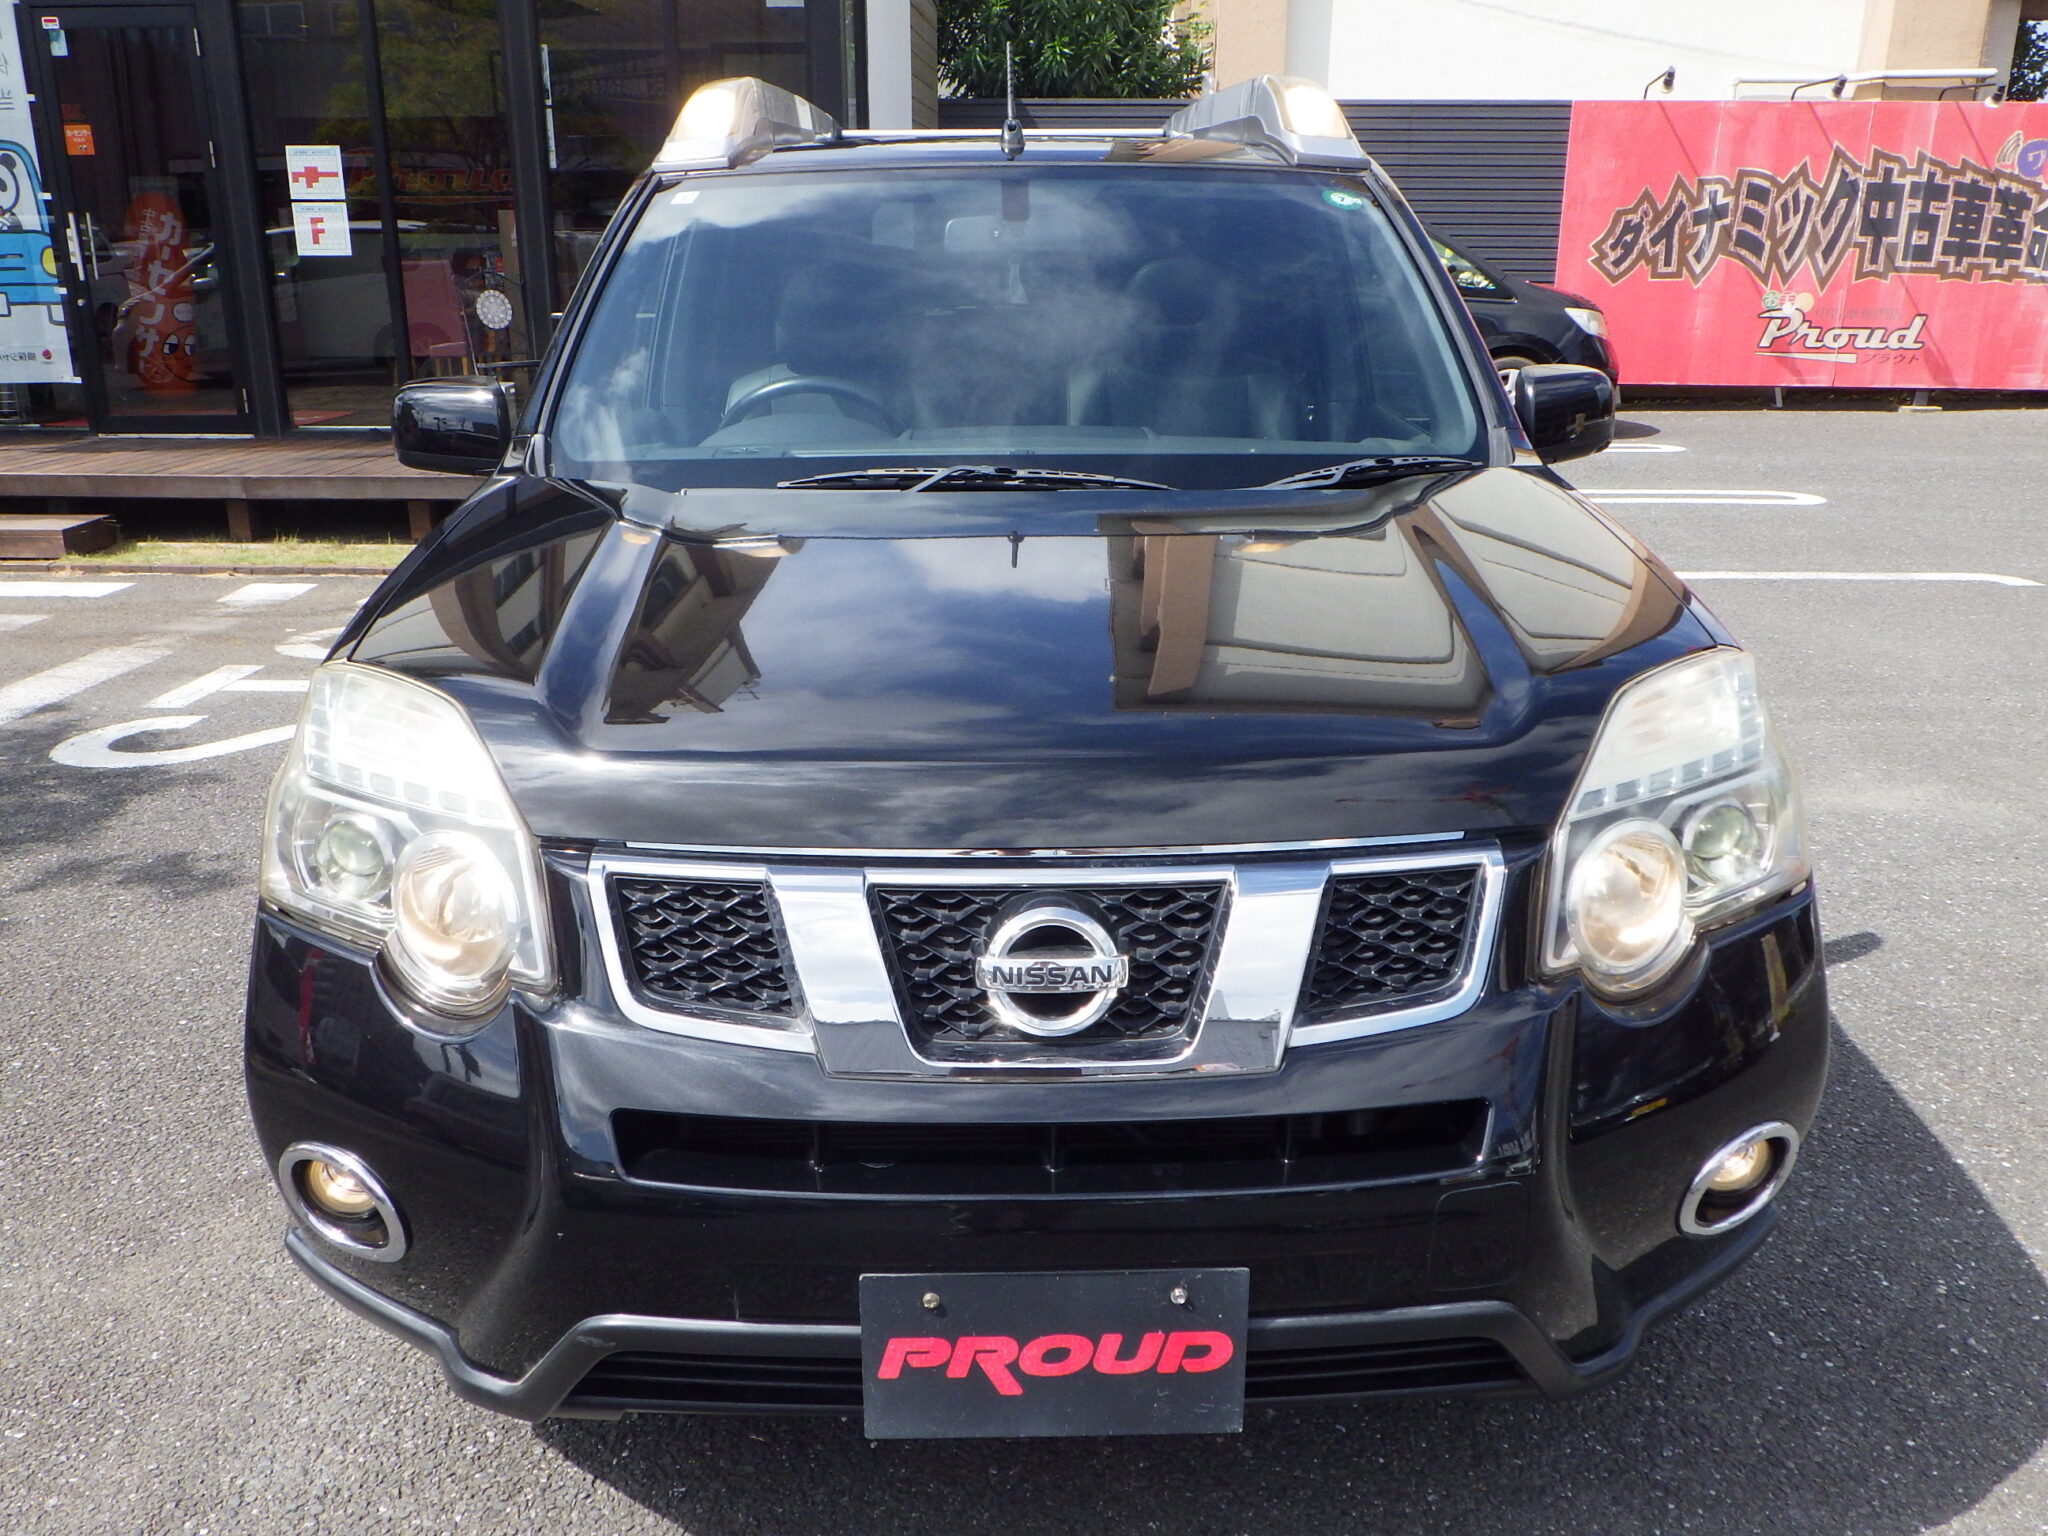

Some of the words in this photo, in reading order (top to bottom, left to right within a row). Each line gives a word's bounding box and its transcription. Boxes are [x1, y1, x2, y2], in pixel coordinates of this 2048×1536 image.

[1757, 308, 1929, 351] Proud
[1862, 353, 1922, 365] プラウド
[991, 964, 1112, 986] NISSAN
[876, 1330, 1235, 1397] PROUD
